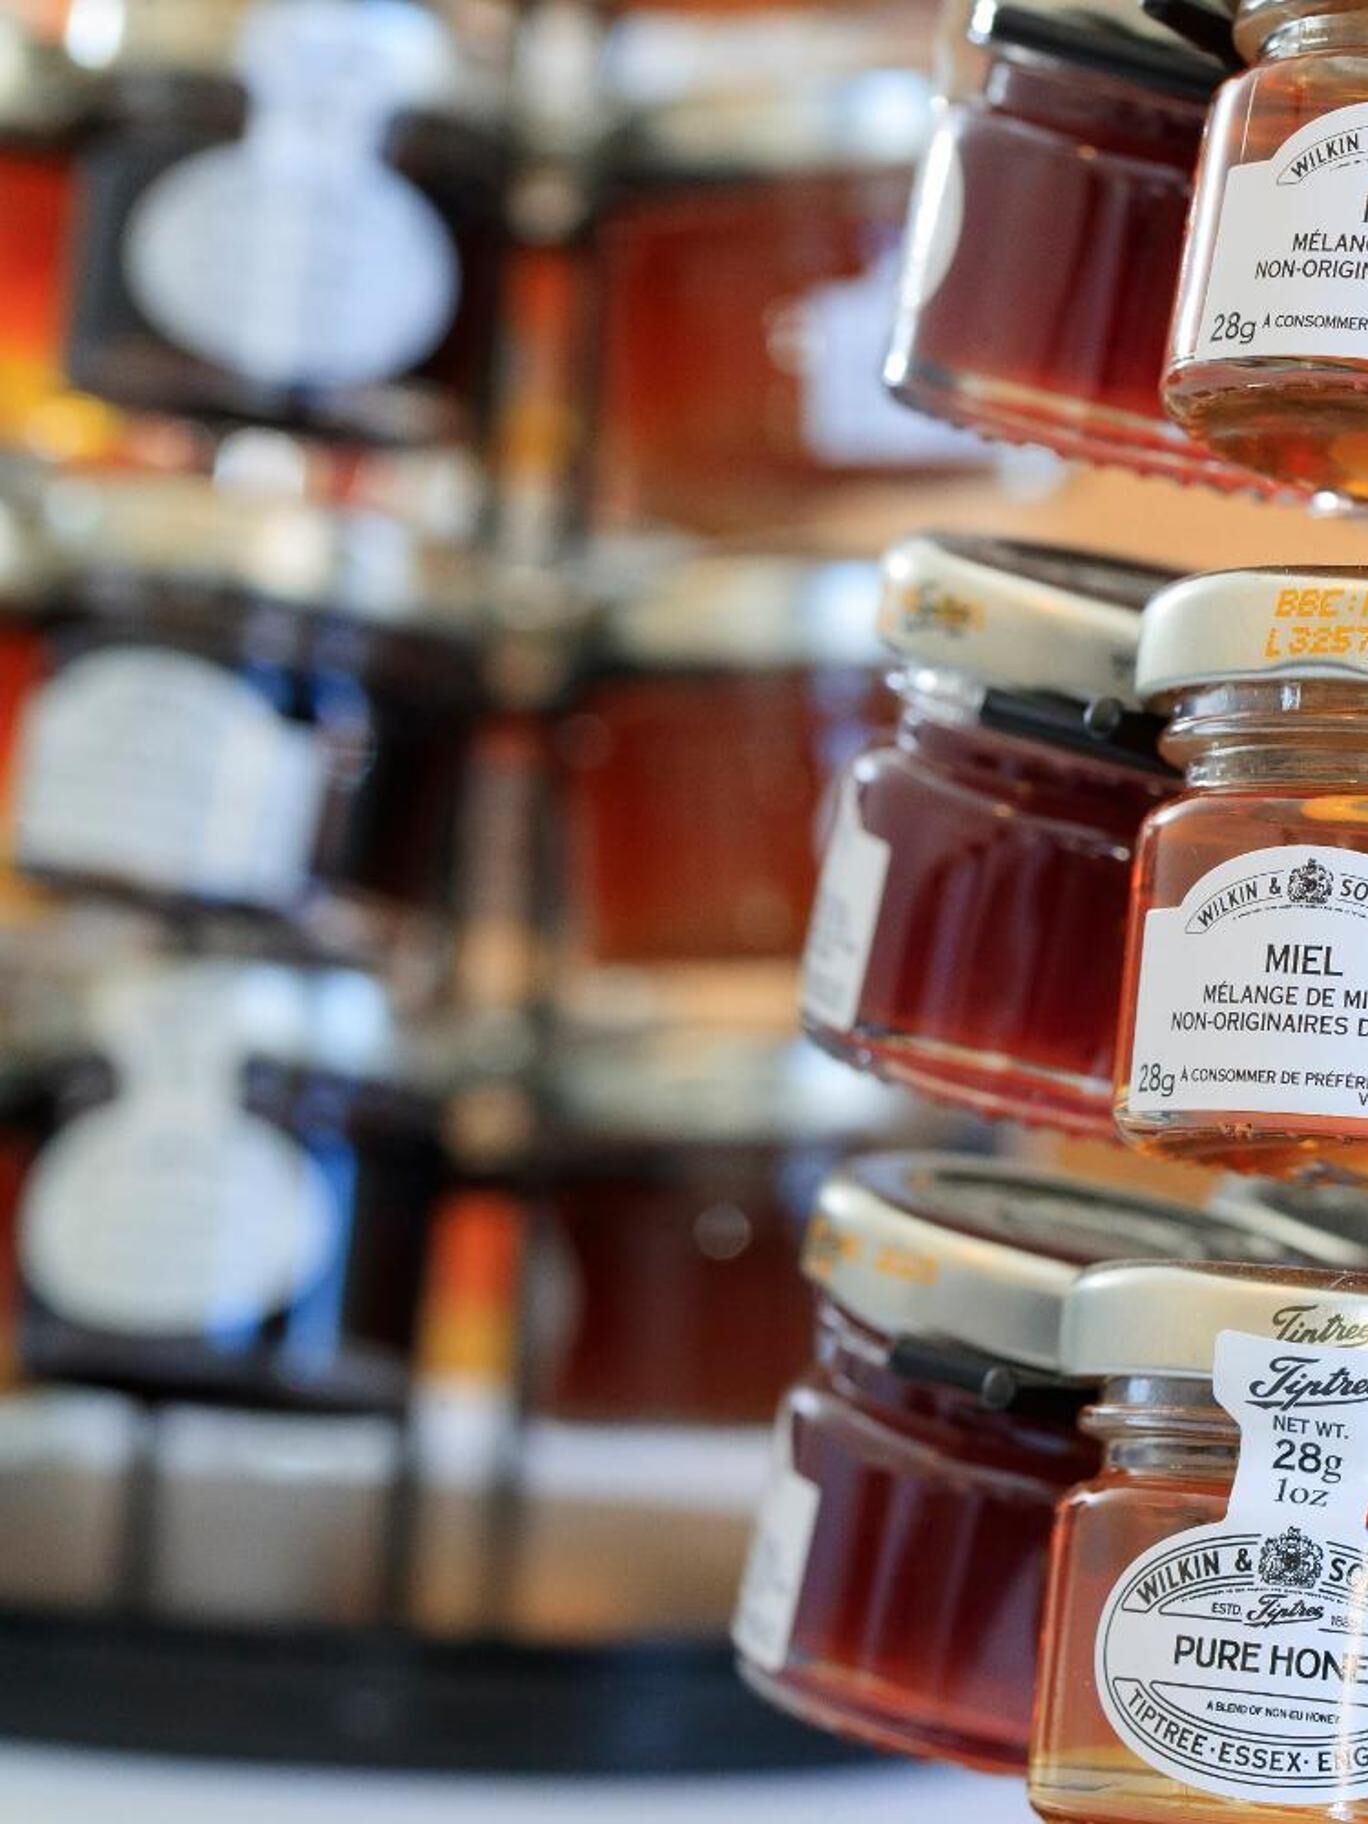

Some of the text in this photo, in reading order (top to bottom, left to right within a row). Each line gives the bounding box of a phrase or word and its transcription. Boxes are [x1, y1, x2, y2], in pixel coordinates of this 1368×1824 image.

[1291, 132, 1360, 178] WILKIN
[1210, 311, 1257, 345] 28g
[1197, 880, 1259, 928] WILKIN
[1268, 876, 1282, 897] &
[1265, 944, 1344, 977] MIEL
[1203, 980, 1299, 1007] MÉLANGE
[1306, 988, 1335, 1008] DE
[1170, 1011, 1349, 1037] NON-ORIGINAIRES
[1138, 1062, 1176, 1097] 28g
[1191, 1068, 1277, 1085] CONSOMMER
[1280, 1070, 1301, 1086] DE
[1273, 1415, 1349, 1440] NET WT.
[1272, 1438, 1343, 1483] 28g
[1274, 1478, 1328, 1508] 1oz
[1136, 1548, 1220, 1606] WILKIN
[1234, 1548, 1253, 1571] &
[1244, 1594, 1324, 1629] Tiptree
[1174, 1635, 1262, 1673] PURE
[1130, 1687, 1206, 1756] TIPTREE
[1218, 1740, 1302, 1774] ESSEX
